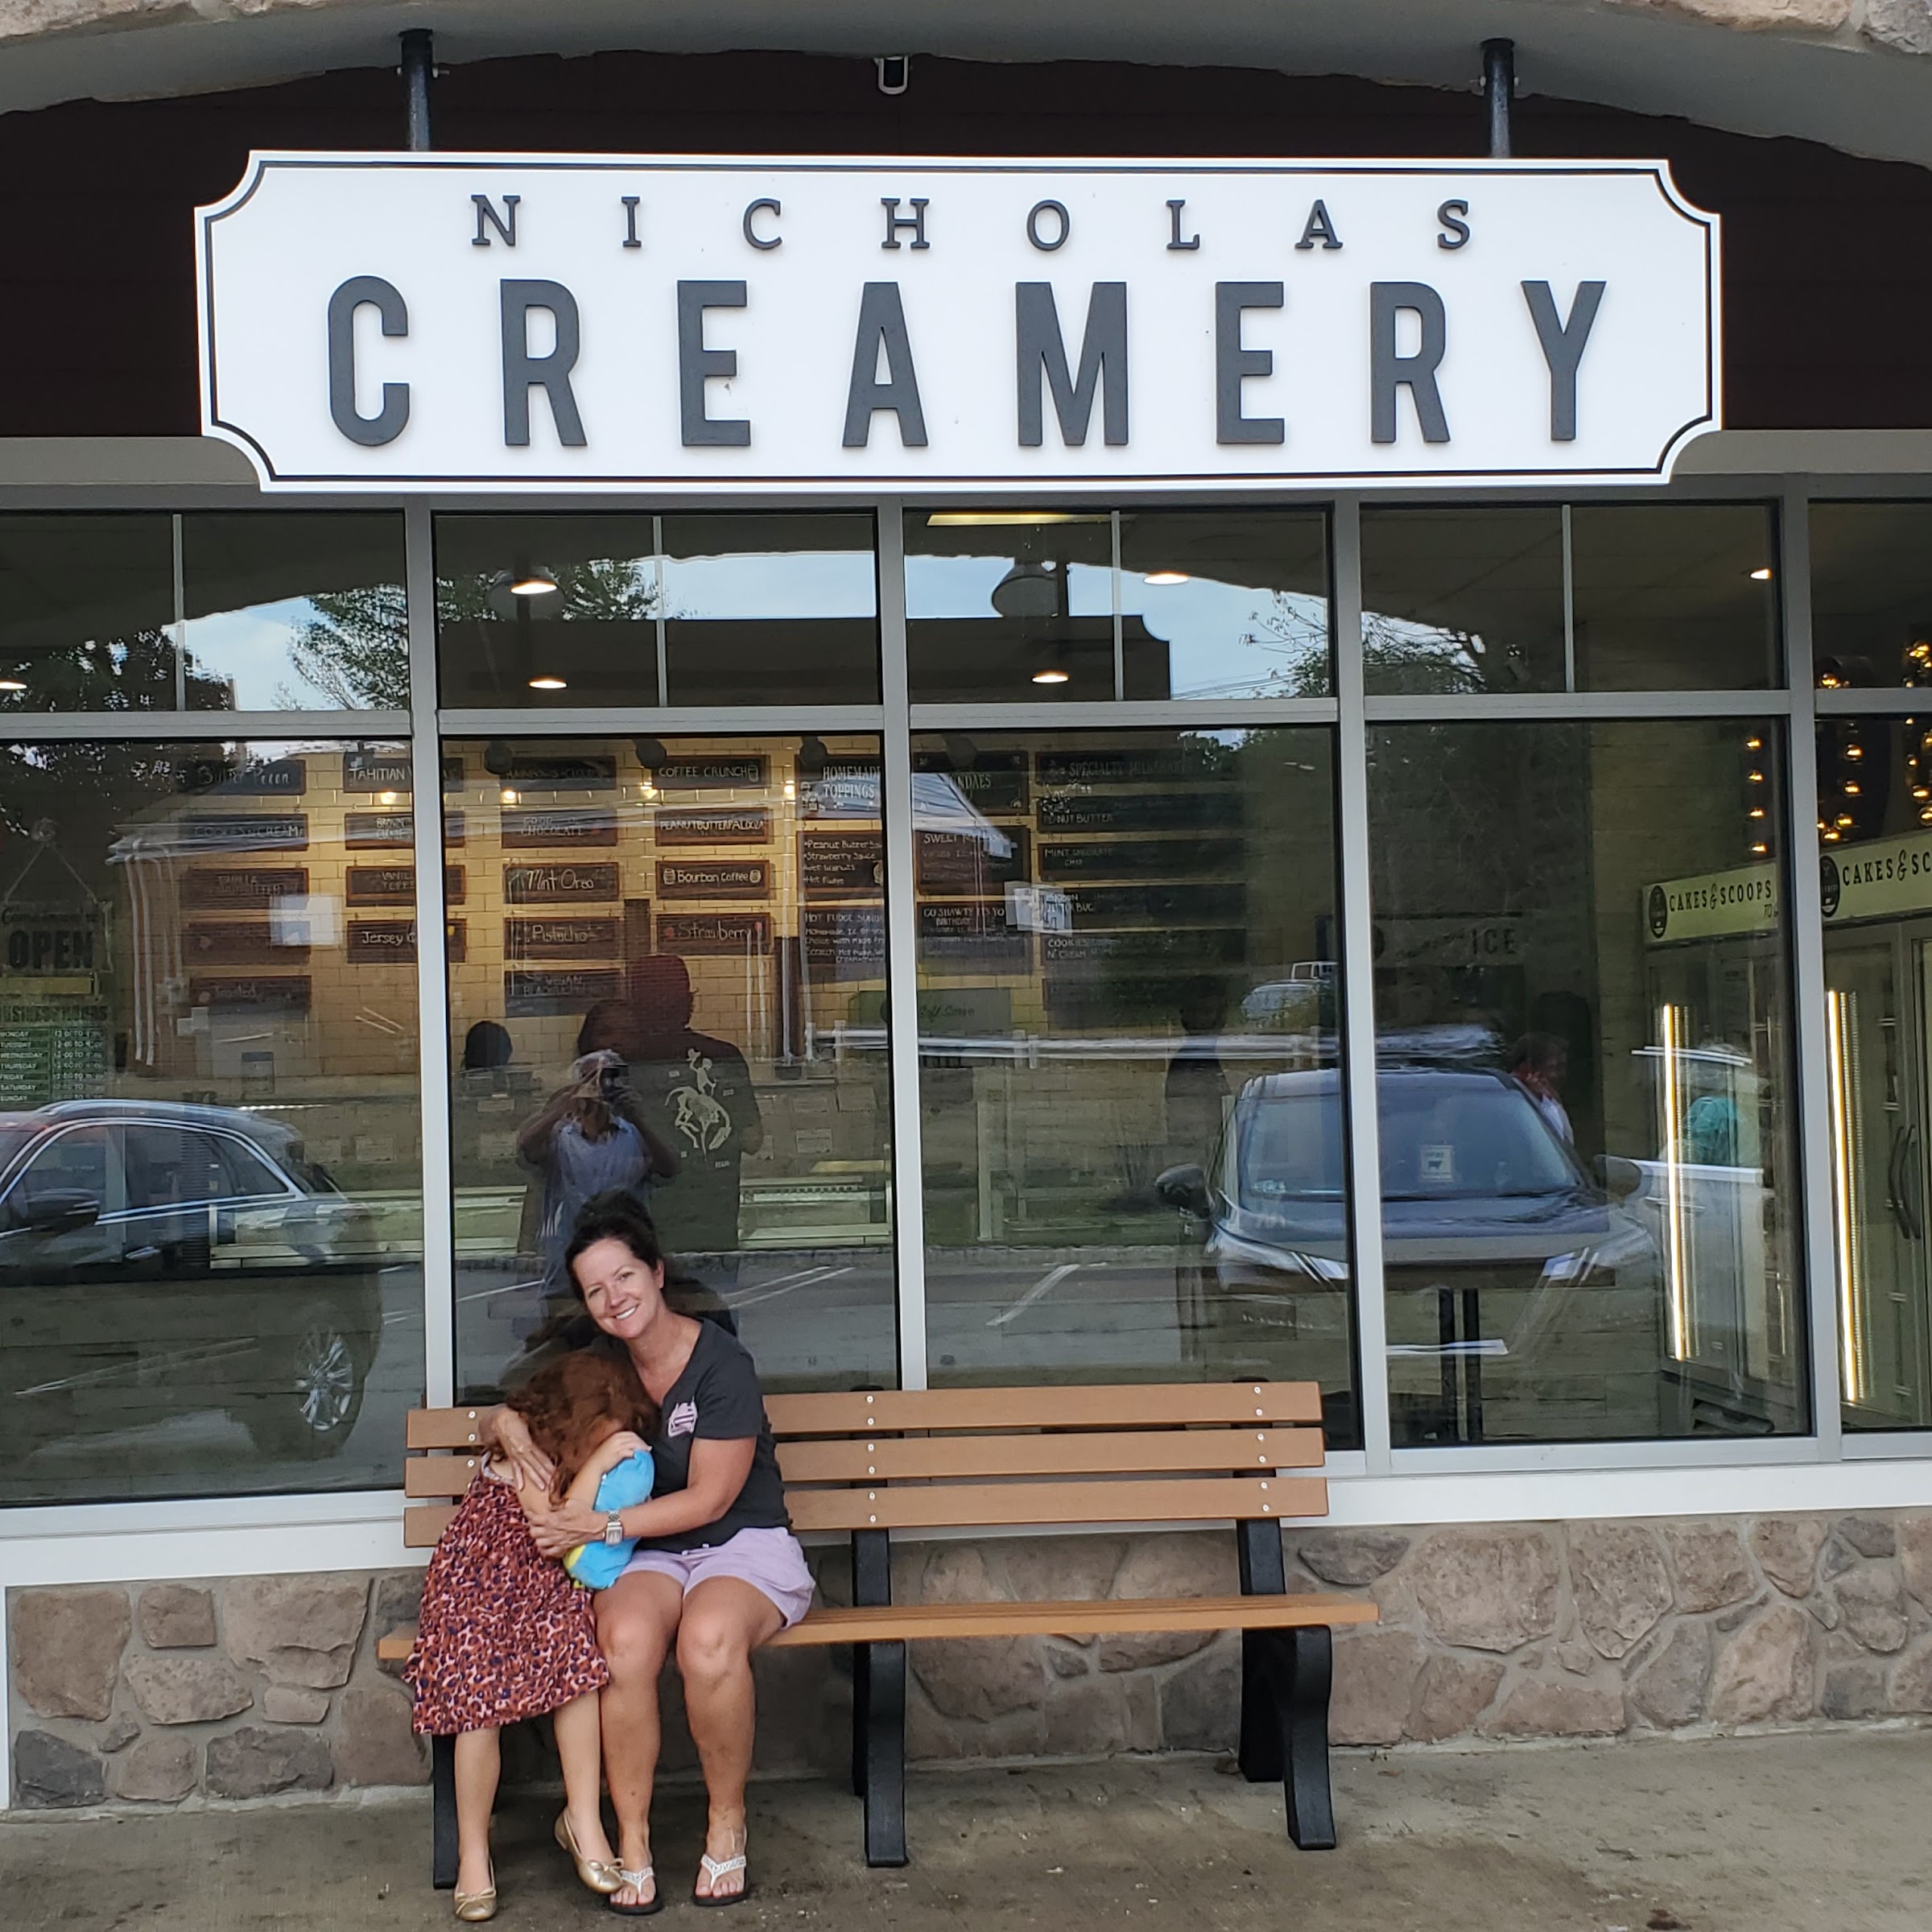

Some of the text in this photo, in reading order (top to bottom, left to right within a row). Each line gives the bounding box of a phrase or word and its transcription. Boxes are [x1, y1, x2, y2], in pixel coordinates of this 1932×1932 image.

[471, 194, 1472, 252] NICHOLAS
[328, 275, 1607, 448] CREAMERY
[352, 768, 405, 781] TAHITIAN
[658, 766, 747, 778] COFFEE CRUNCH
[823, 783, 875, 799] TOPPINGS
[677, 869, 749, 884] Bourbon Coffee
[1842, 848, 1932, 886] CAKES & SC
[527, 868, 595, 891] Mint Oreo
[1670, 889, 1707, 912] CAKES
[1719, 879, 1772, 906] SCOOPS
[857, 913, 881, 923] SUND
[9, 930, 93, 969] OPEN
[361, 931, 404, 947] Jersey
[1472, 927, 1517, 956] ICE
